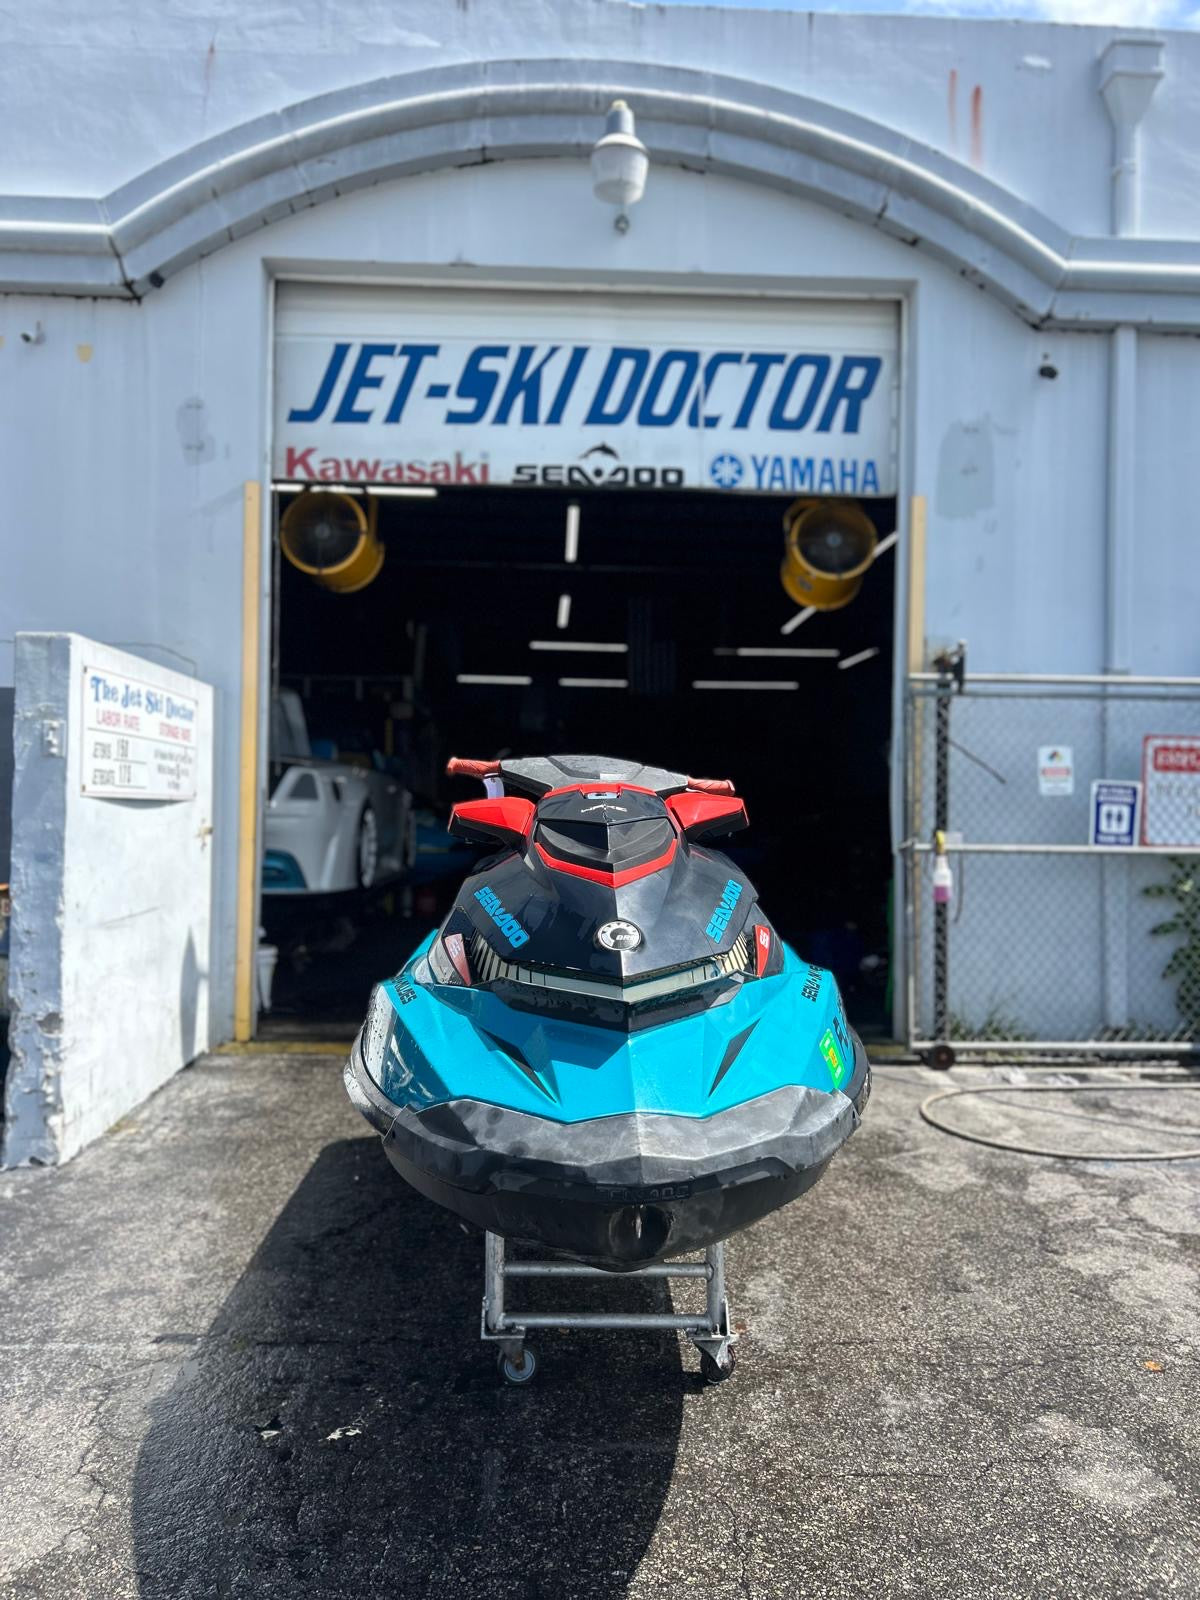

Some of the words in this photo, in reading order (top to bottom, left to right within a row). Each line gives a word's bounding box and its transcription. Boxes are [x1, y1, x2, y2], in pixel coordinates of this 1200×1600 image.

[287, 342, 590, 426] JET-SKI
[582, 346, 882, 434] DOCTOR
[285, 445, 489, 484] Kawasaki
[751, 454, 880, 494] YAMAHA
[90, 676, 119, 702] The
[121, 684, 142, 708] Jet
[145, 690, 163, 714] Ski
